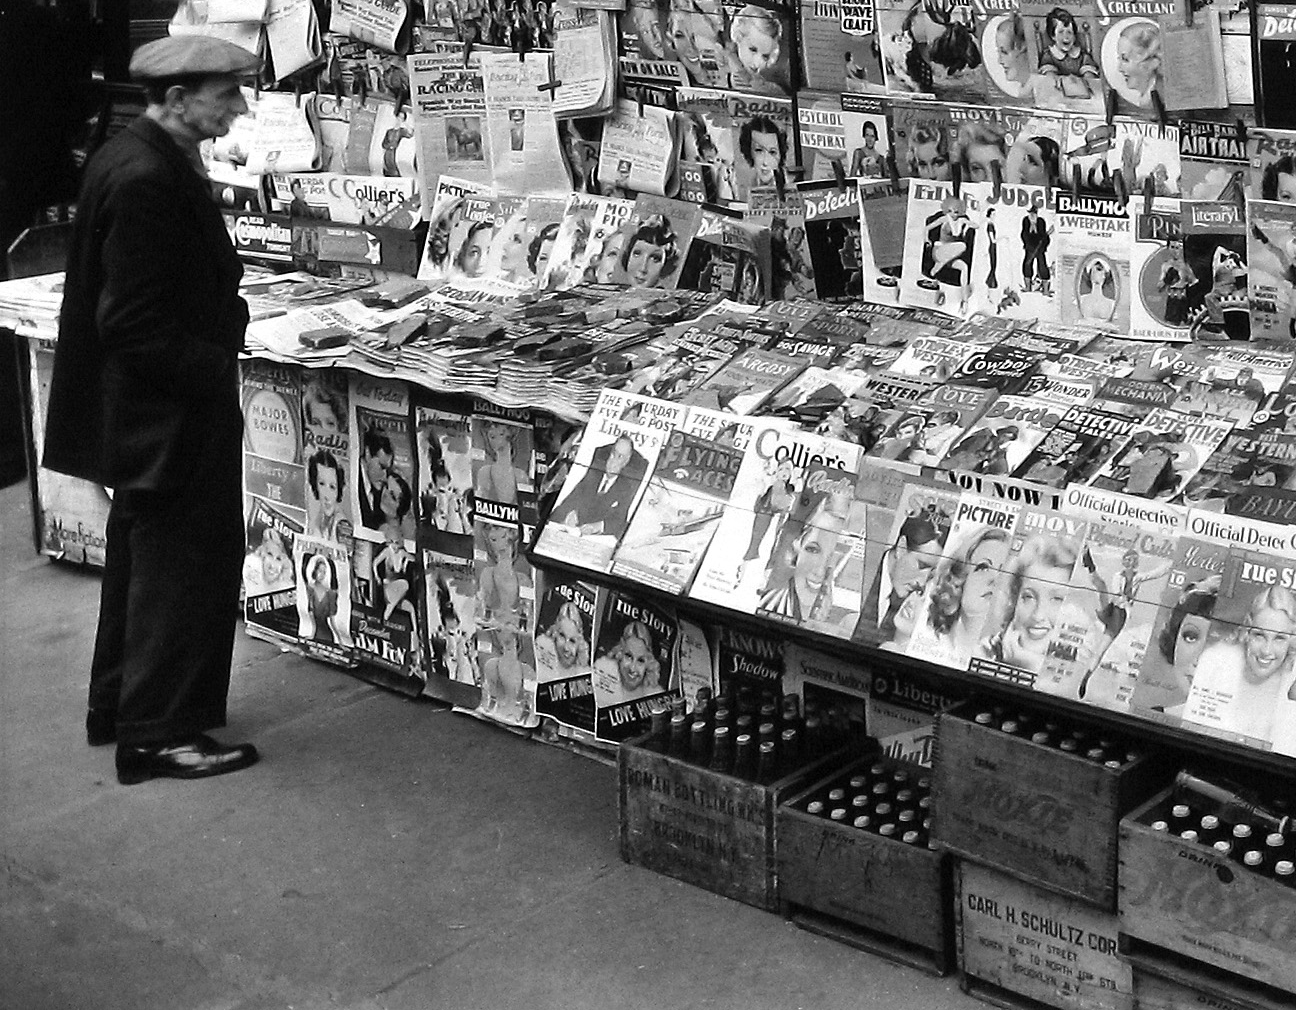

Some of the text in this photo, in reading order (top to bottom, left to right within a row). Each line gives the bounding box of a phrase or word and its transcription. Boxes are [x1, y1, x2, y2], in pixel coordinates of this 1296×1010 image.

[961, 351, 1032, 376] Cowboy
[602, 394, 623, 408] THE
[648, 416, 677, 432] POST
[756, 427, 848, 470] Collier's
[956, 502, 1015, 532] PICTURE
[1067, 490, 1179, 527] Official Detective
[1191, 517, 1245, 544] Official
[610, 707, 637, 727] LOVE
[968, 892, 1002, 921] CARL
[1006, 905, 1018, 925] H.
[1021, 910, 1084, 948] SCHULTZ
